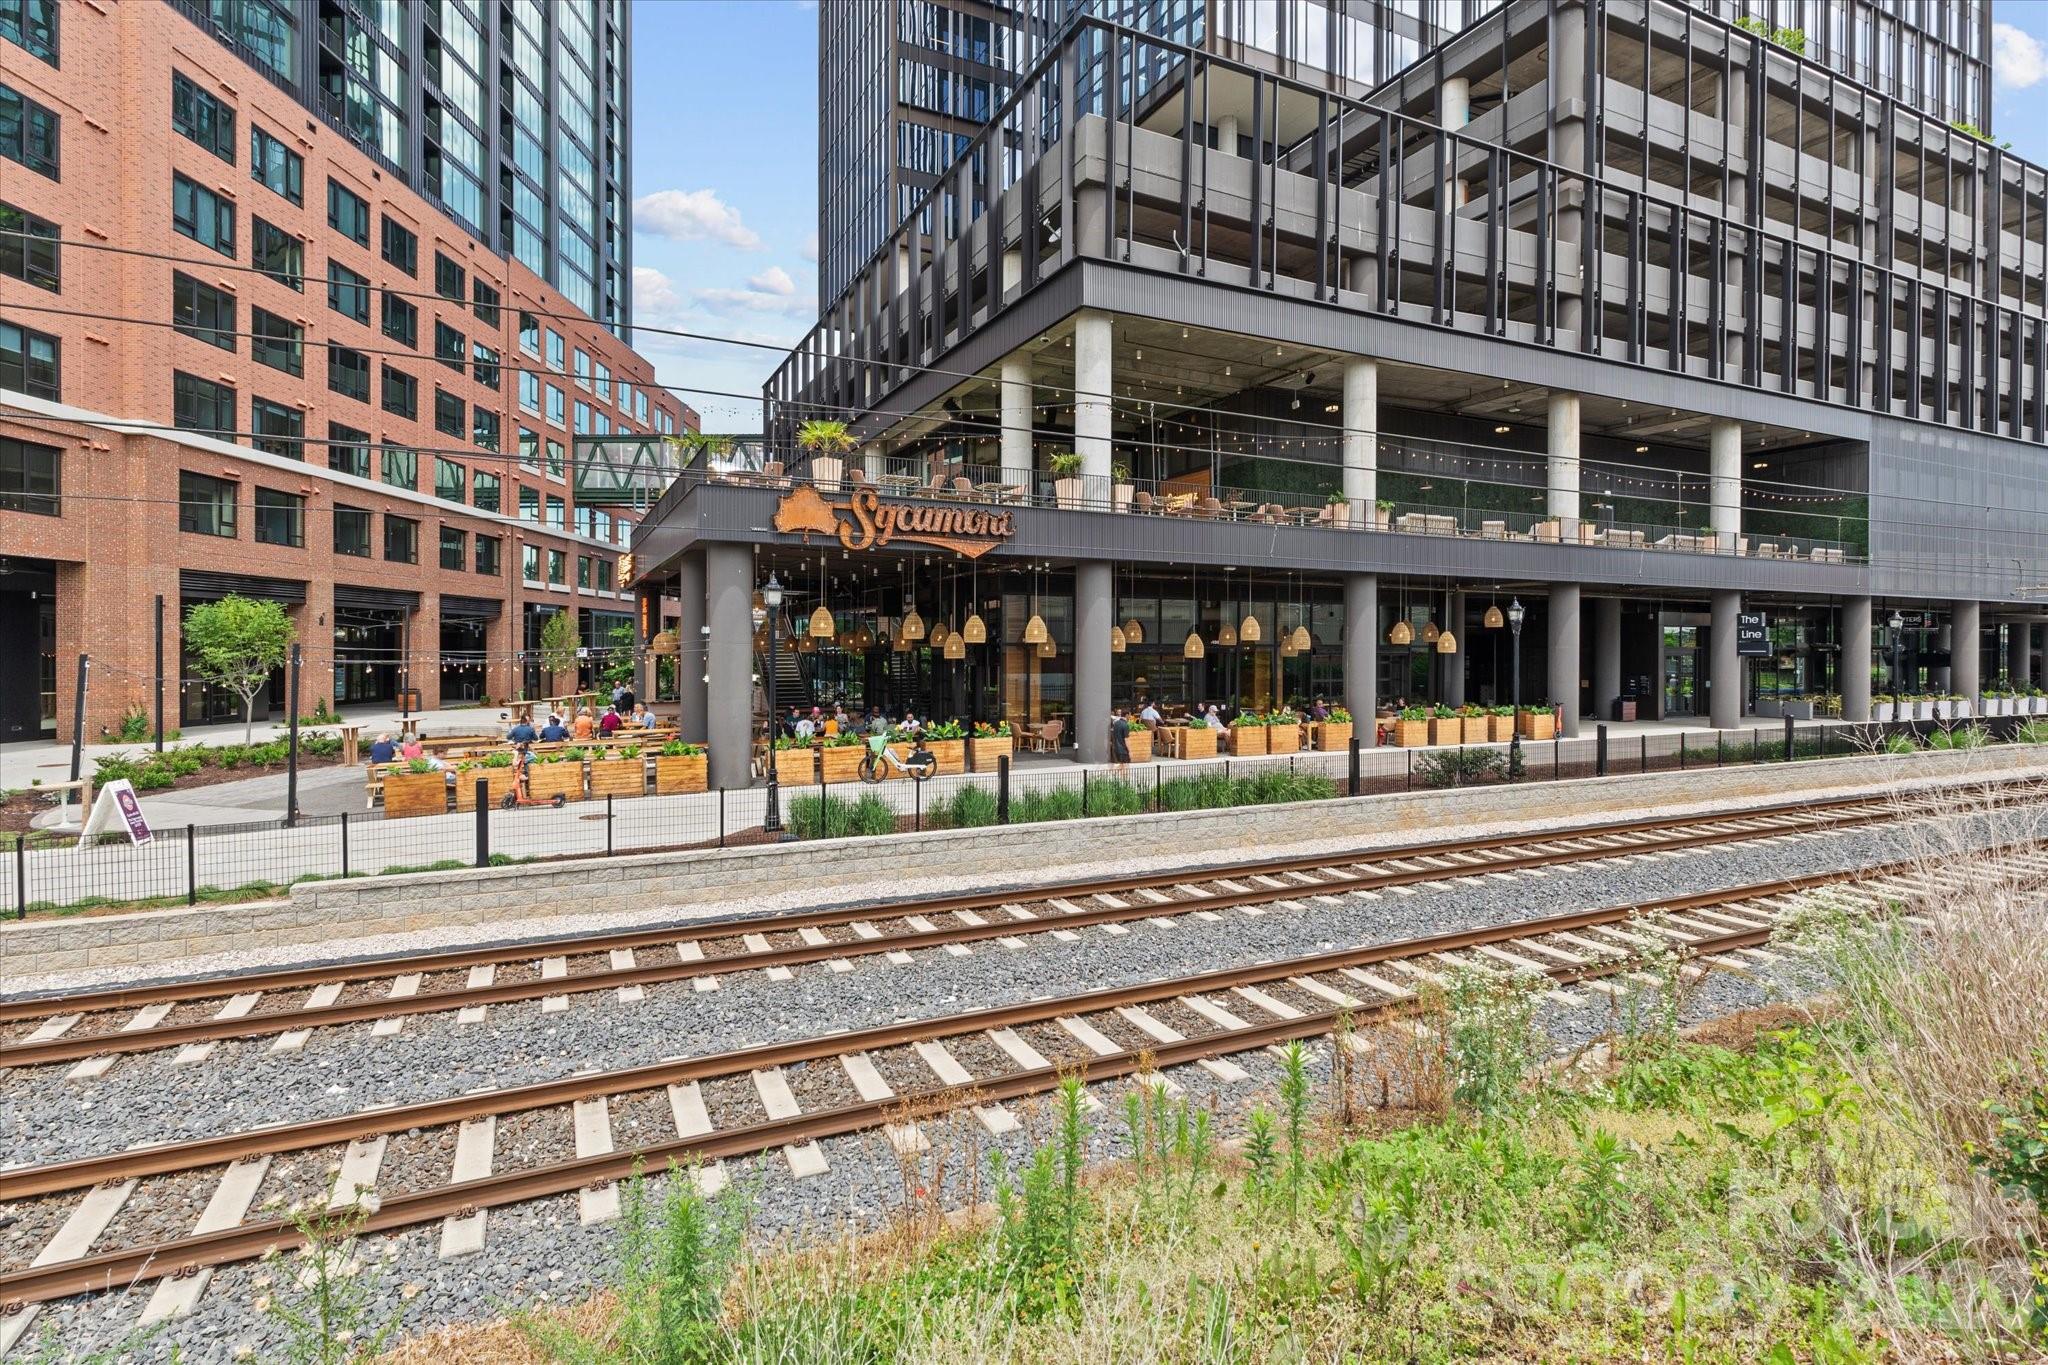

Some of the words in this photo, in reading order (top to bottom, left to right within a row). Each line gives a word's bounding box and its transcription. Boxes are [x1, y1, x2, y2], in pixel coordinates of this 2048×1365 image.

[839, 487, 1017, 550] Sycamore
[1741, 616, 1759, 624] The
[1741, 630, 1762, 639] Line
